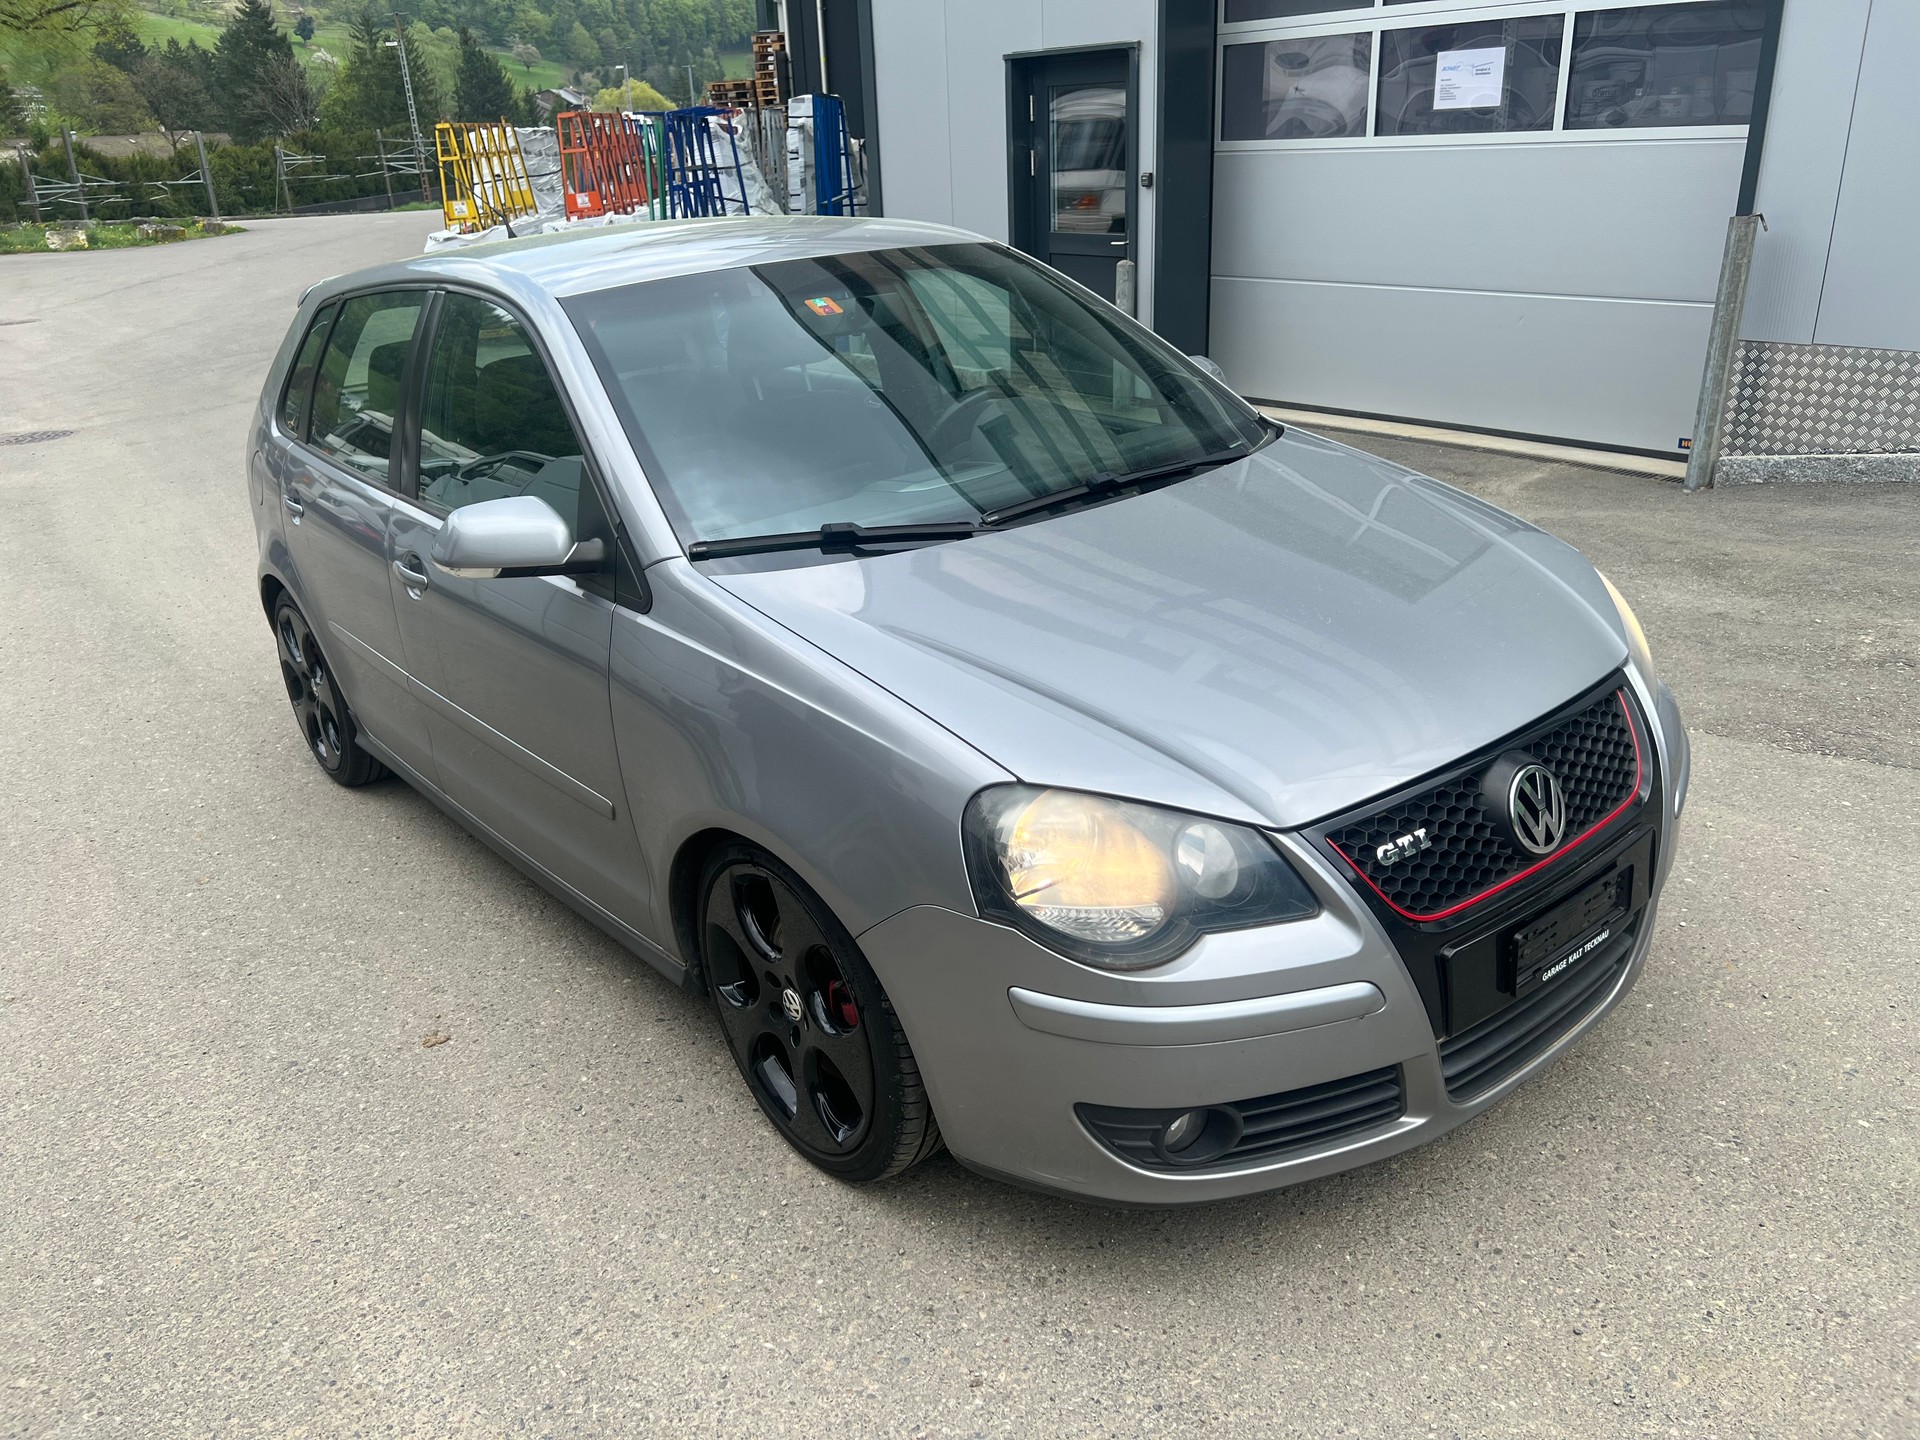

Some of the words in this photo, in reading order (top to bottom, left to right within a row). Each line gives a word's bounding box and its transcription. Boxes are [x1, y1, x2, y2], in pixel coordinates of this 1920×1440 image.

[1377, 828, 1432, 866] GTI
[1542, 959, 1567, 981] GARAGE
[1568, 947, 1583, 964] KALT
[1584, 929, 1609, 953] TECKNAU
